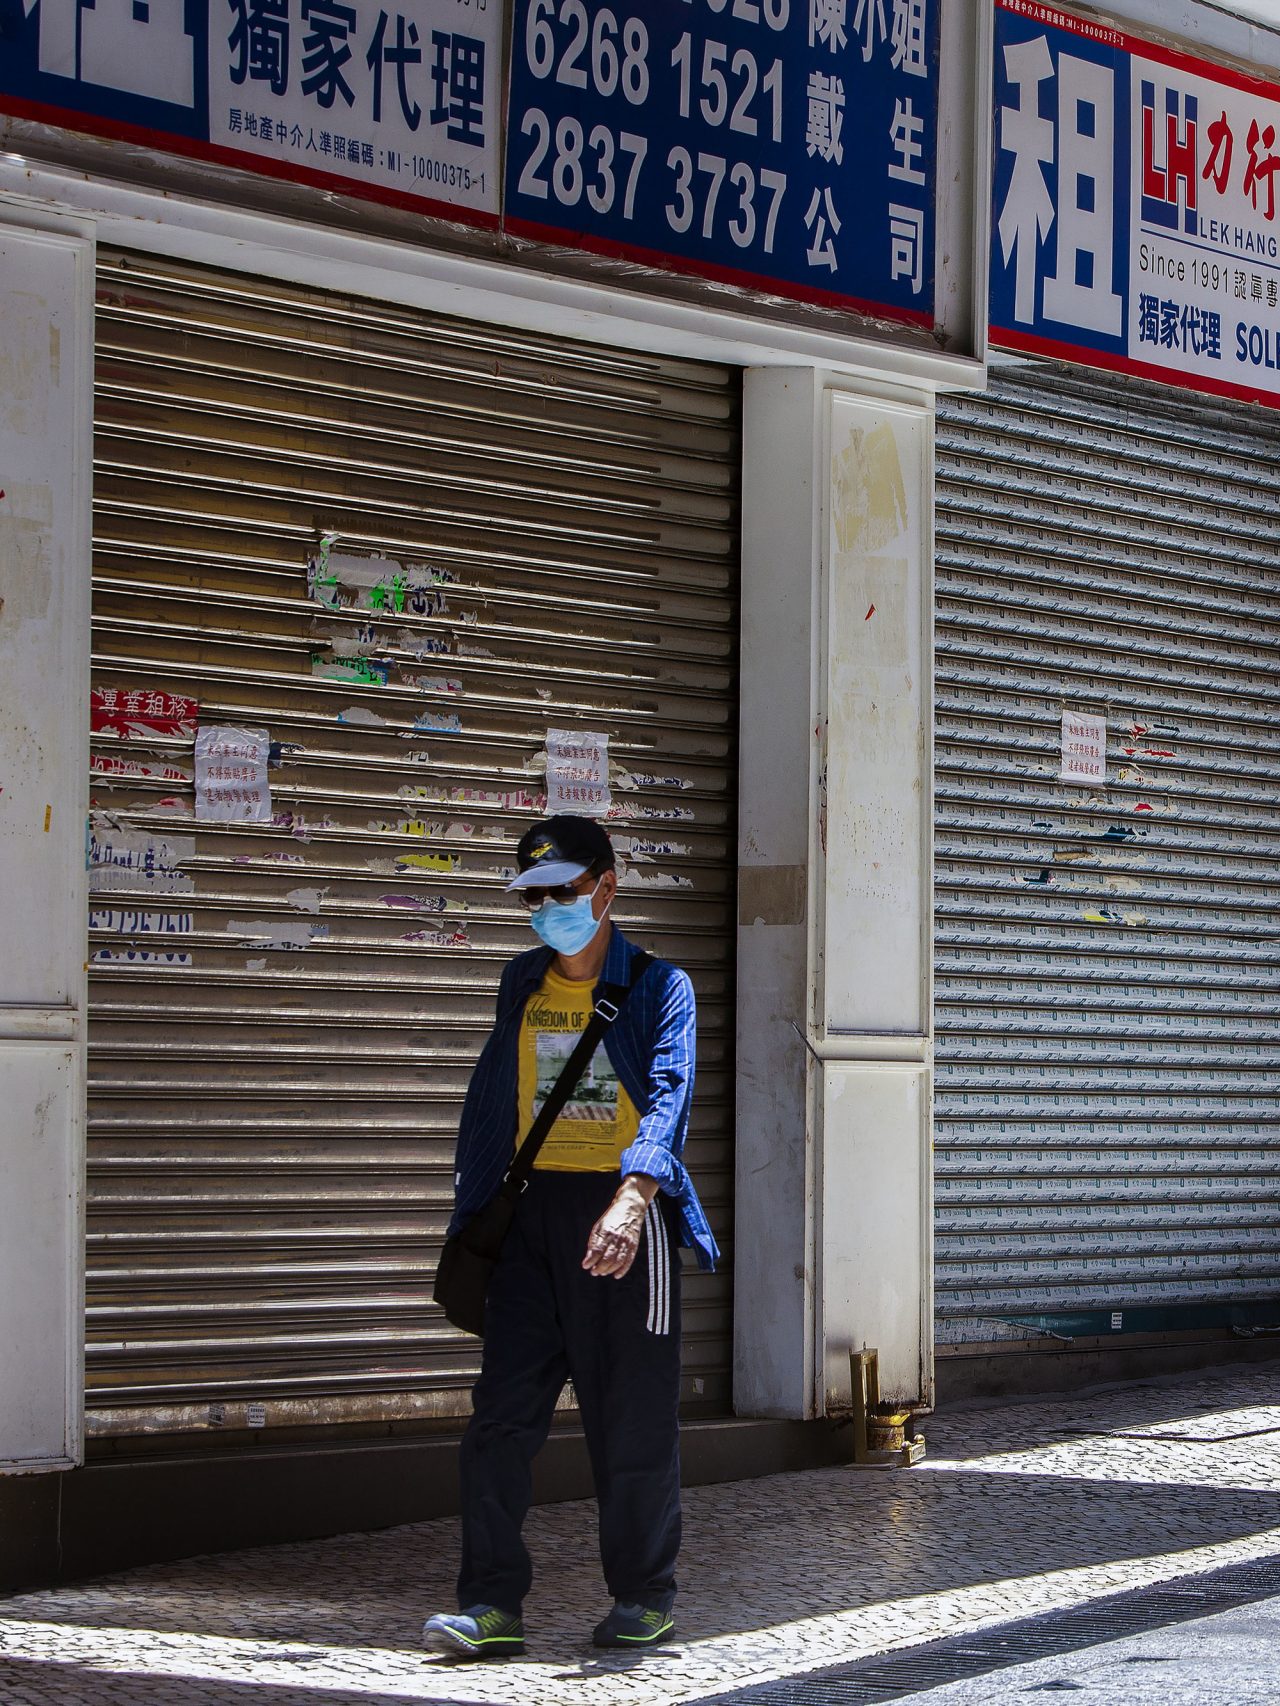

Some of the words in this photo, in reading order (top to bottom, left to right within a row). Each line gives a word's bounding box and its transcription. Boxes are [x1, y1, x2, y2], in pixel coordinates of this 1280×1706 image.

[228, 0, 486, 148] 獨家代理
[525, 0, 649, 105] 6268
[671, 31, 784, 143] 1521
[808, 0, 928, 78] 陳小姐
[517, 107, 648, 220] 2837
[665, 145, 787, 254] 3737
[998, 34, 1122, 338] 租
[1139, 244, 1185, 282] Since
[1191, 259, 1228, 293] 1991
[1200, 217, 1230, 245] LEK
[1235, 227, 1277, 258] HANG
[1138, 292, 1222, 360] 獨家代理
[526, 1011, 569, 1028] KINGDOM
[571, 1012, 585, 1028] OF
